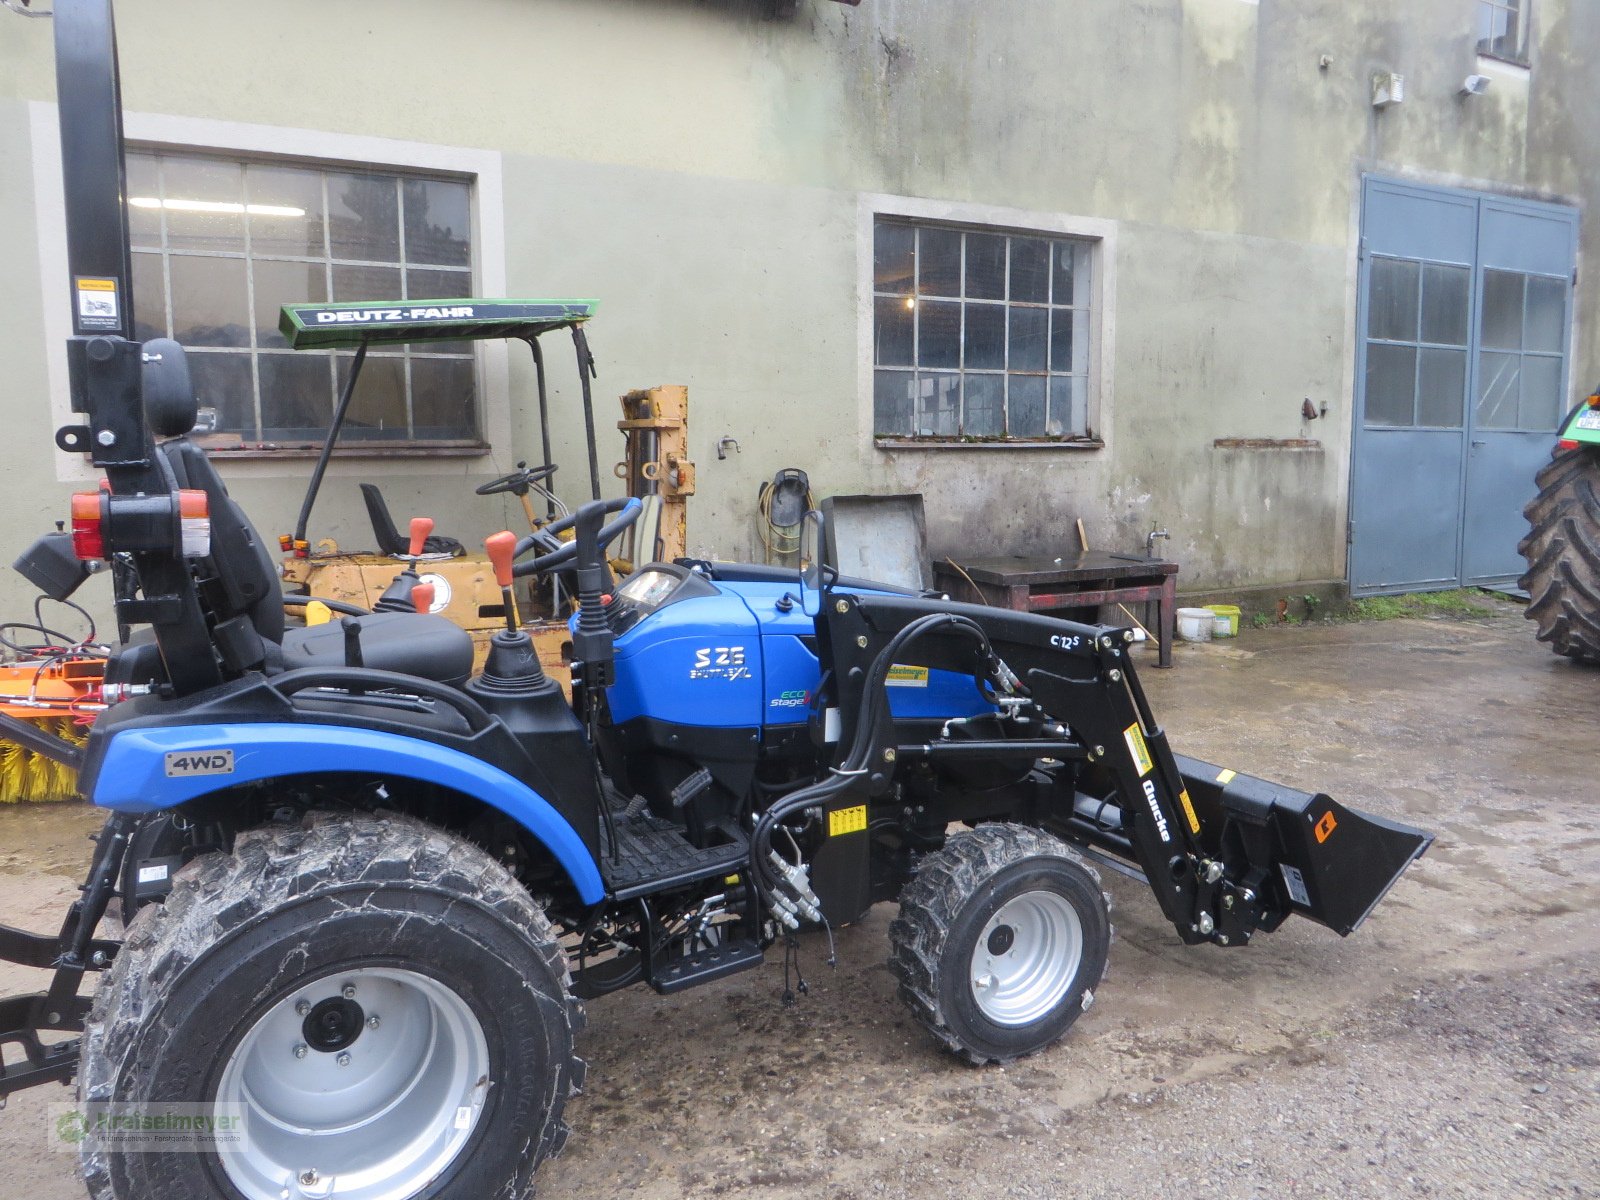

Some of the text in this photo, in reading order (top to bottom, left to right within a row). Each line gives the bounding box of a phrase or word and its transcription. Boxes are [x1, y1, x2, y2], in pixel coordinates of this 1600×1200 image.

[316, 306, 474, 323] DEUTZ-FAHR
[780, 690, 806, 699] ECO
[172, 755, 228, 771] 4WD
[1142, 779, 1171, 842] Quicke
